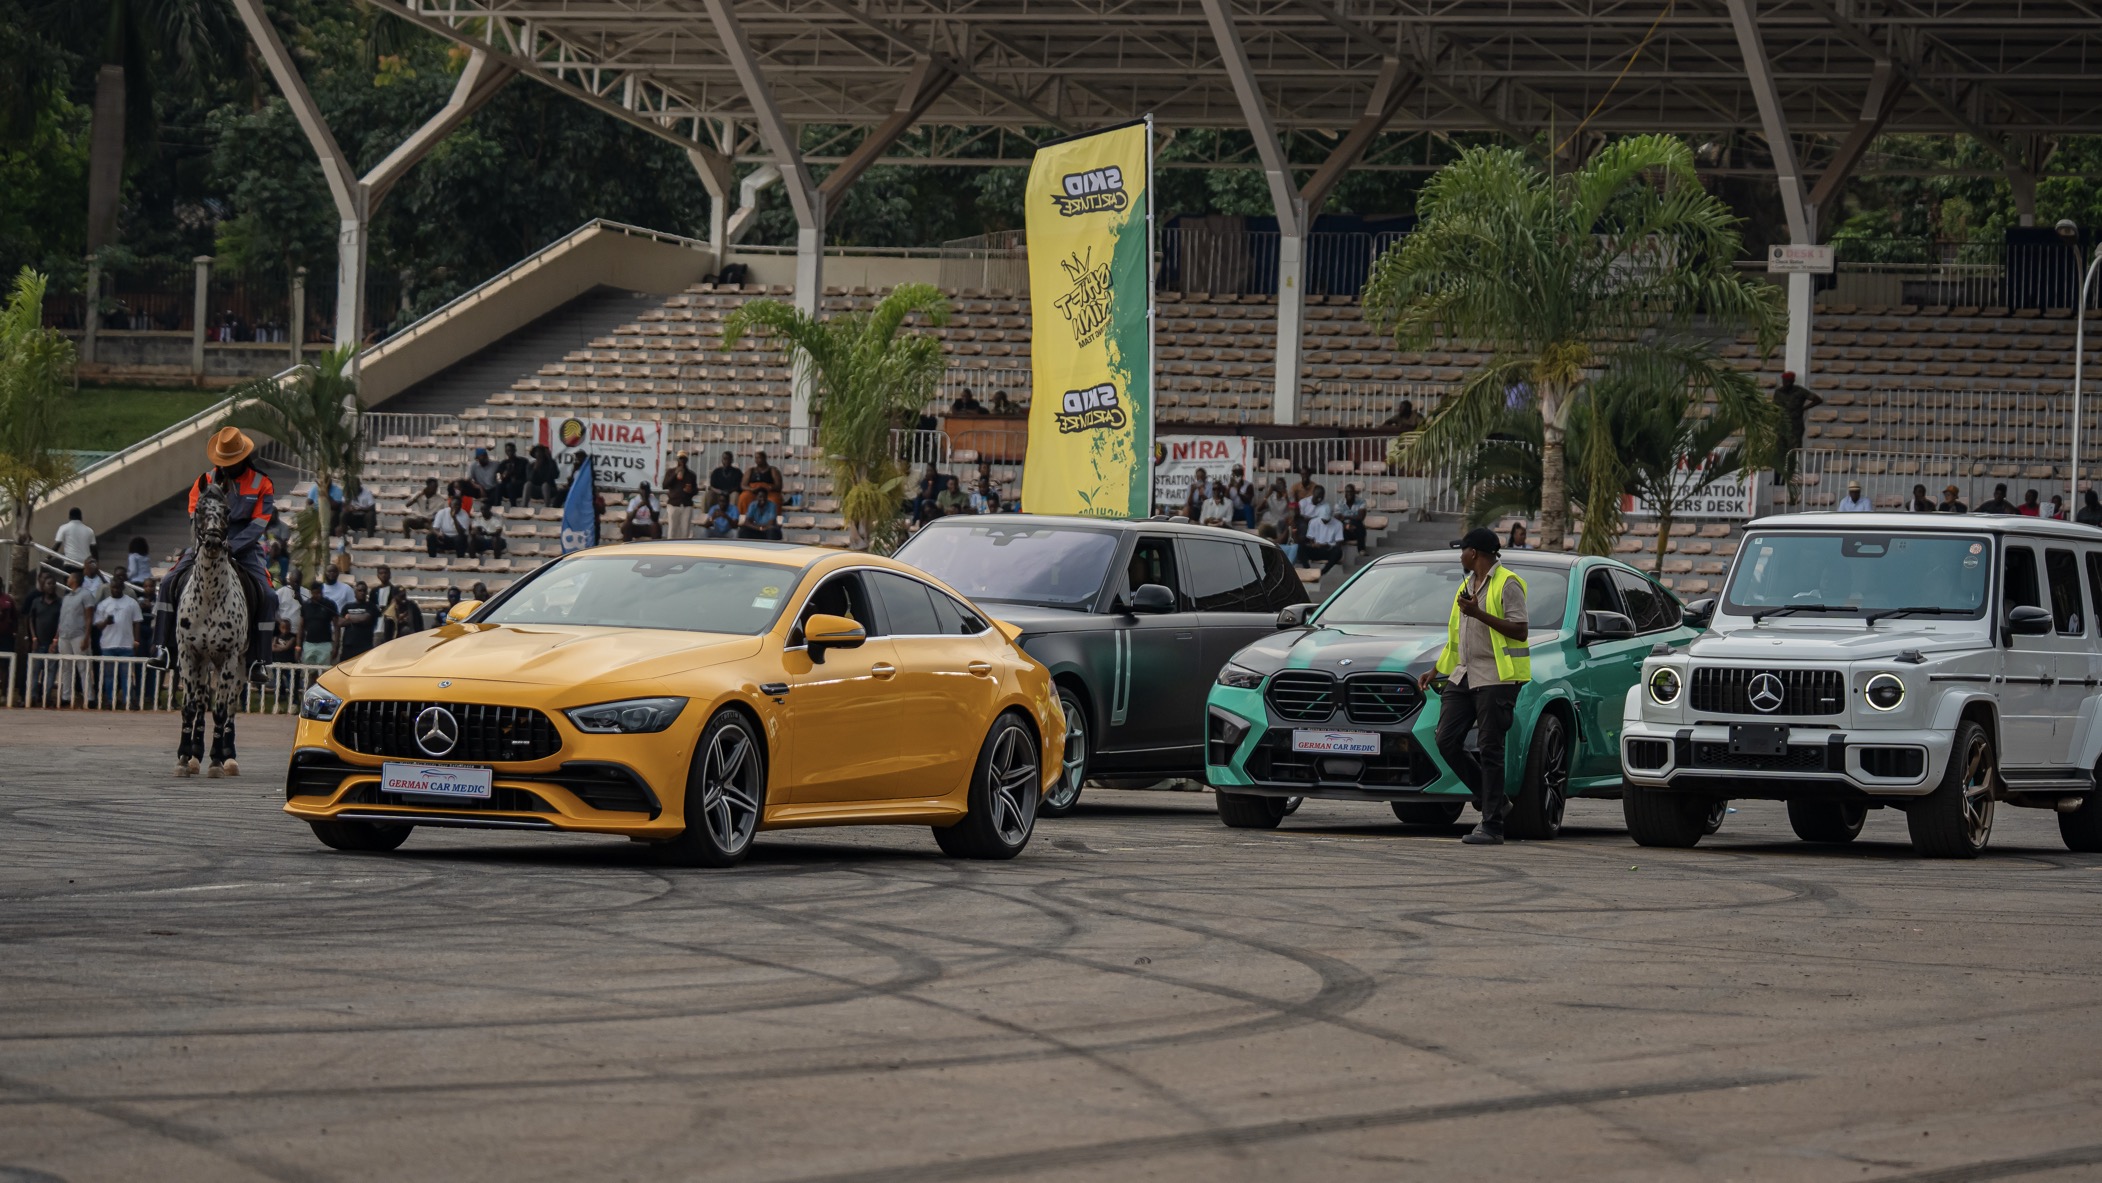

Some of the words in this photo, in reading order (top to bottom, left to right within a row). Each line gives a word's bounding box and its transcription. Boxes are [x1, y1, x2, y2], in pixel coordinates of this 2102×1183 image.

[1786, 249, 1815, 258] DESK
[590, 423, 646, 444] NIRA
[1172, 440, 1230, 461] NIRA
[592, 454, 646, 470] TATUS
[593, 469, 626, 483] ESK
[1155, 474, 1195, 486] STRATION
[1166, 488, 1188, 499] PART
[1707, 500, 1744, 512] DESK
[1298, 741, 1332, 750] GERMAN
[1332, 743, 1349, 751] CAR
[1349, 744, 1375, 752] MEDIC
[388, 778, 429, 790] GERMAN
[430, 781, 451, 792] CAR
[451, 783, 485, 794] MEDIC
